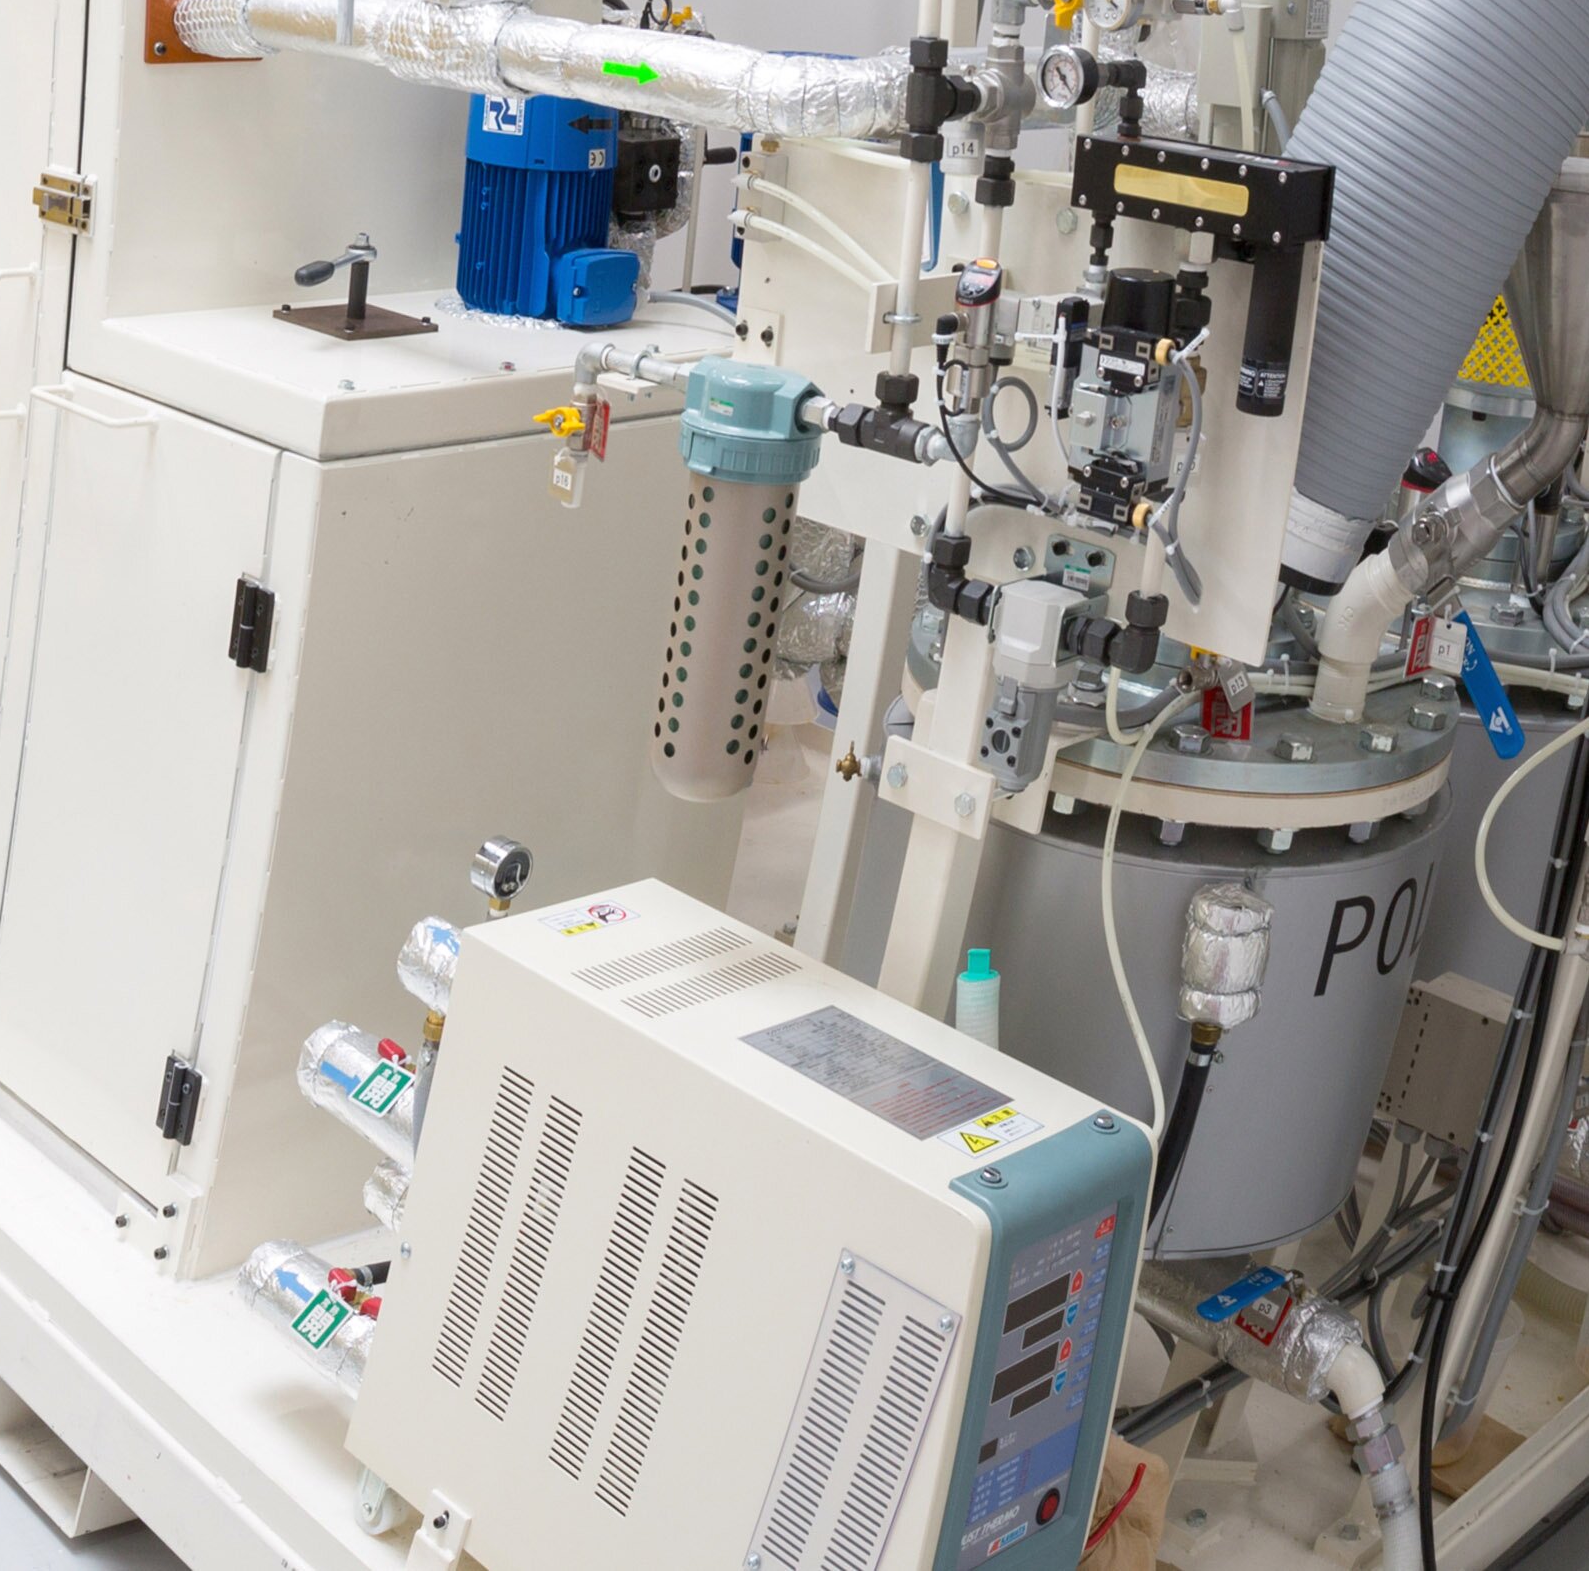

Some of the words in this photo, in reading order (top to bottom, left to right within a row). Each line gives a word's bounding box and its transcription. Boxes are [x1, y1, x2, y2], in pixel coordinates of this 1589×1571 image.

[952, 141, 974, 158] p14
[1438, 644, 1451, 656] p1
[1230, 675, 1245, 694] p13
[1258, 1302, 1273, 1316] p3
